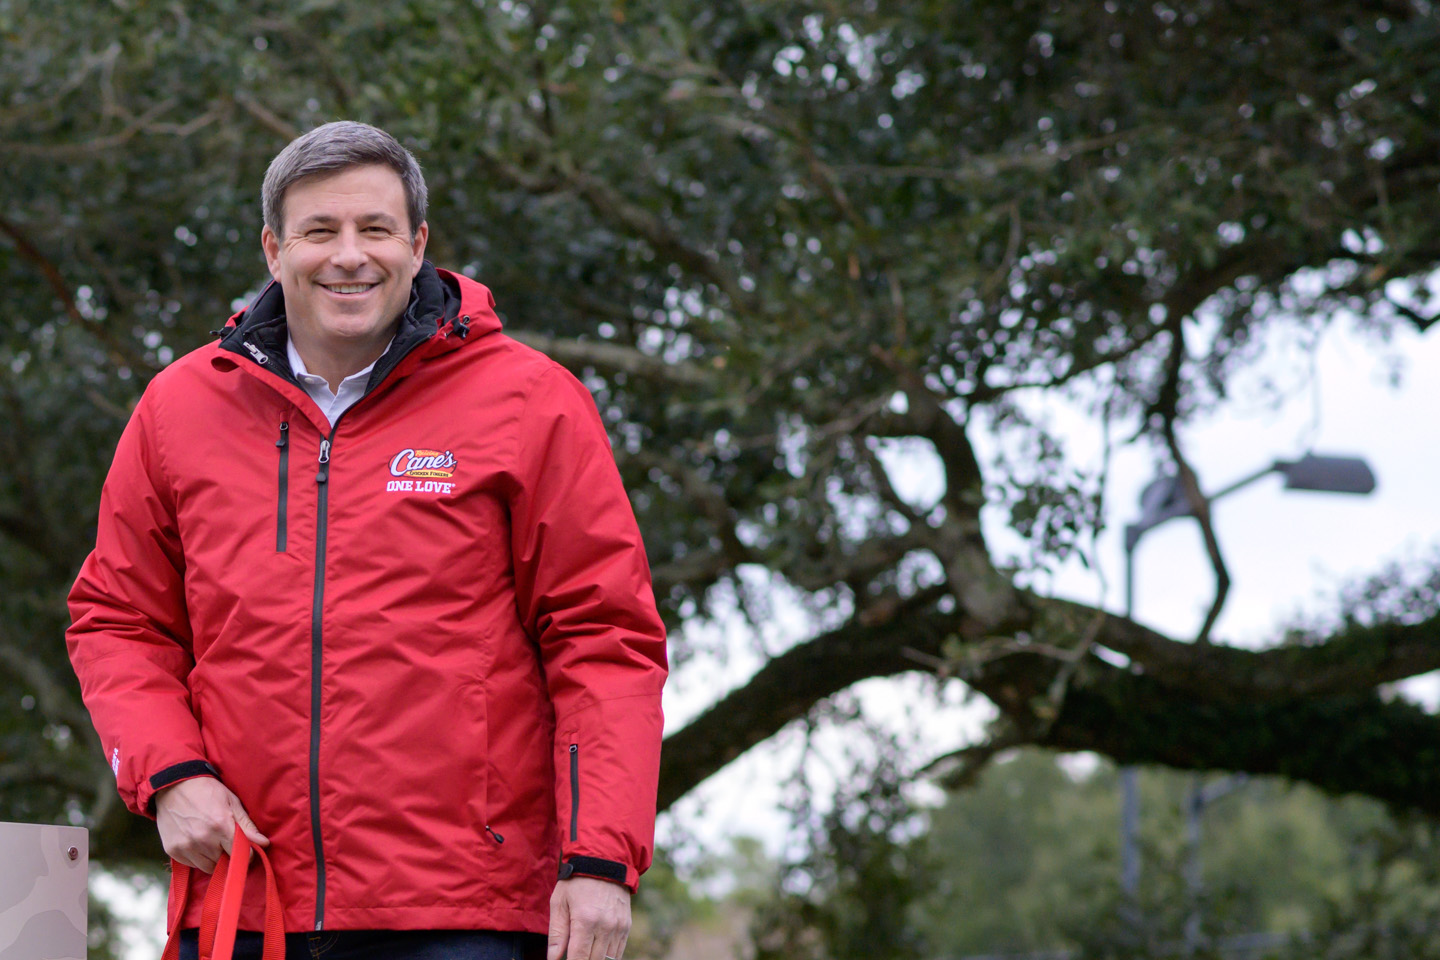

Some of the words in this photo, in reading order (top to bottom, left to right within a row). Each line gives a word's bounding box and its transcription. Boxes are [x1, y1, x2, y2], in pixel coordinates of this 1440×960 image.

[390, 448, 457, 477] Cane's
[386, 480, 413, 492] ONE
[415, 480, 452, 494] LOVE
